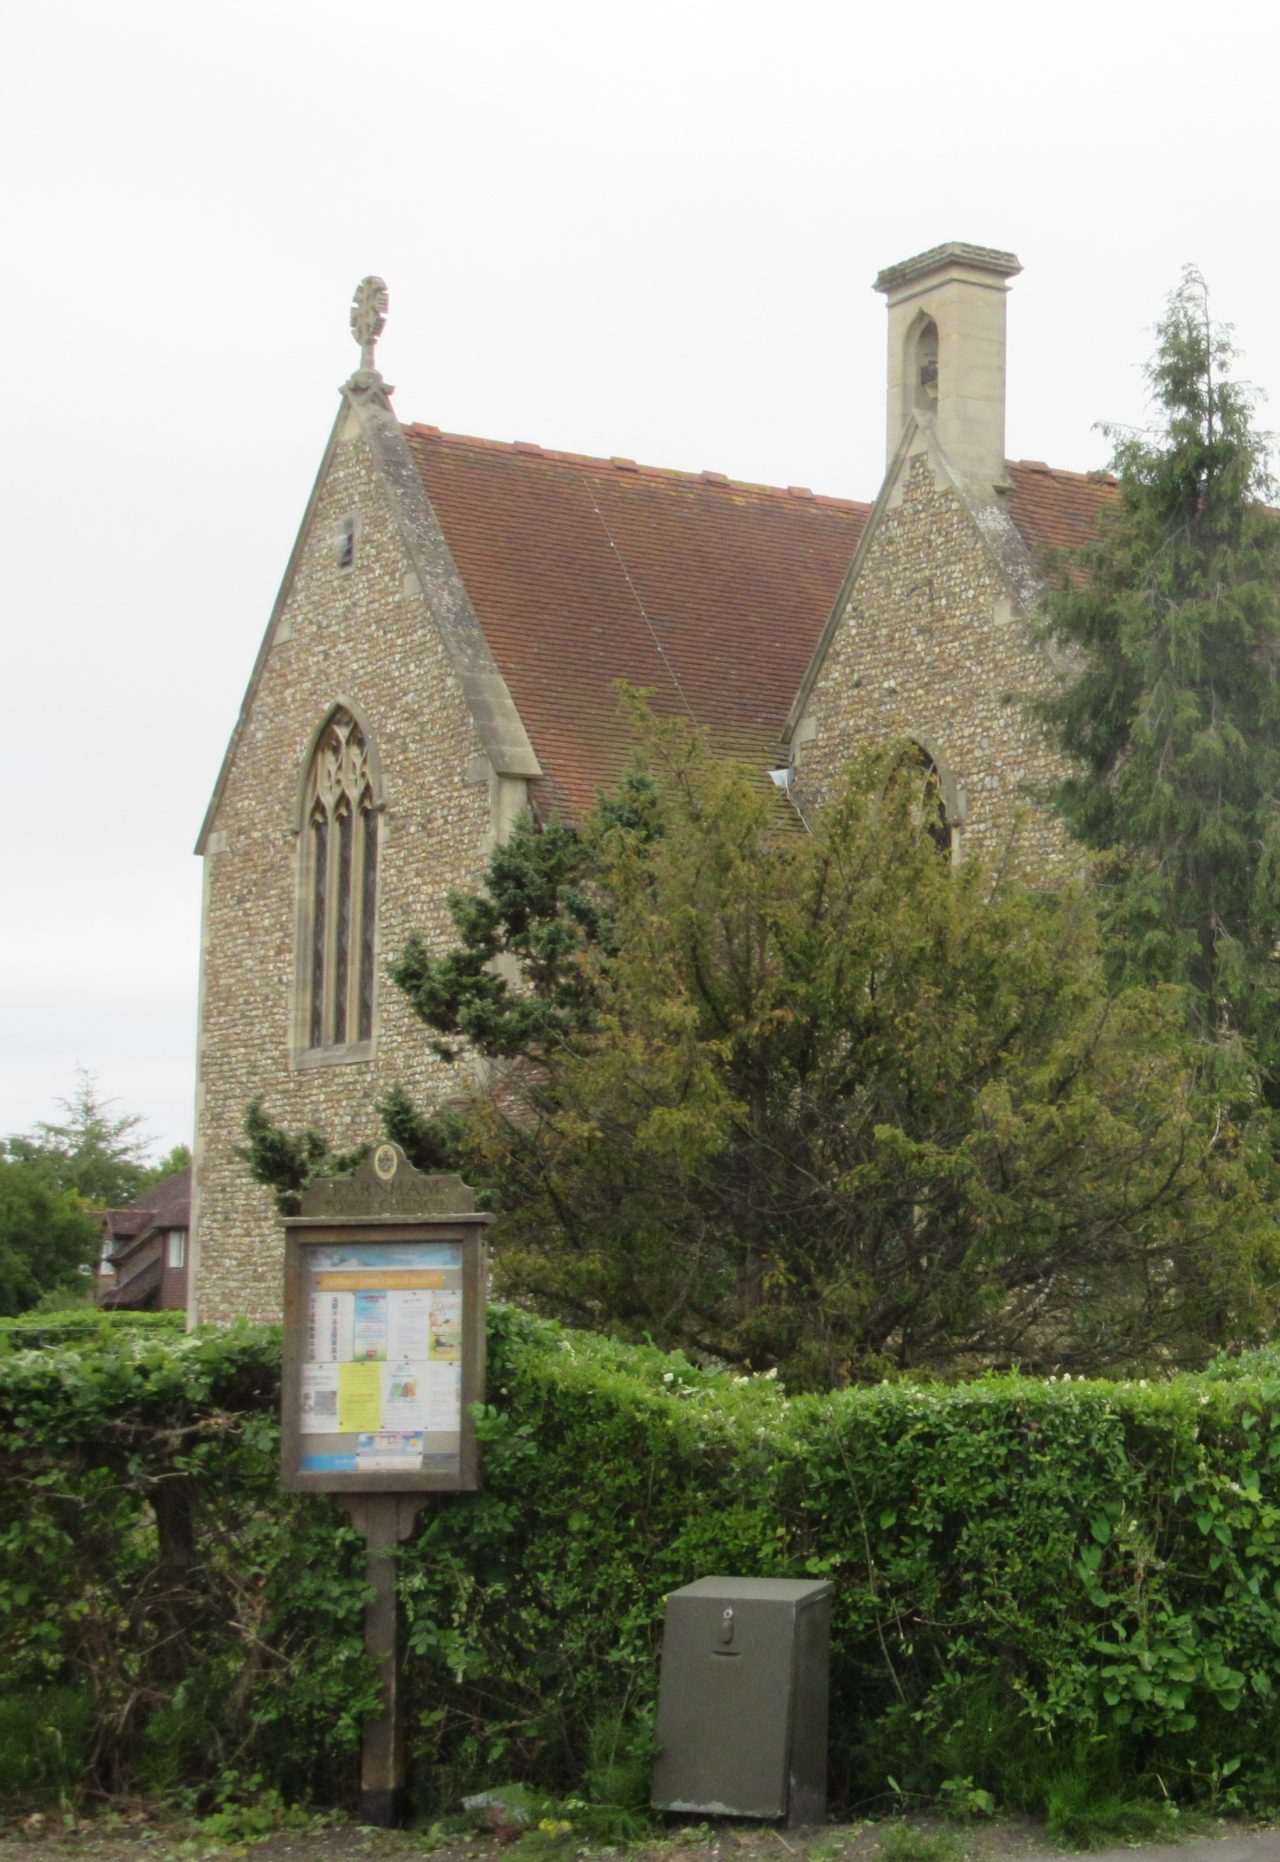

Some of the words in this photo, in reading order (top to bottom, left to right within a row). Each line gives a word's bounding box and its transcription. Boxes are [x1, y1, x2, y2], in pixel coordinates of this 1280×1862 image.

[333, 1180, 441, 1197] FARNHAM
[325, 1198, 370, 1212] TOWN
[379, 1198, 447, 1211] COUNCIL
